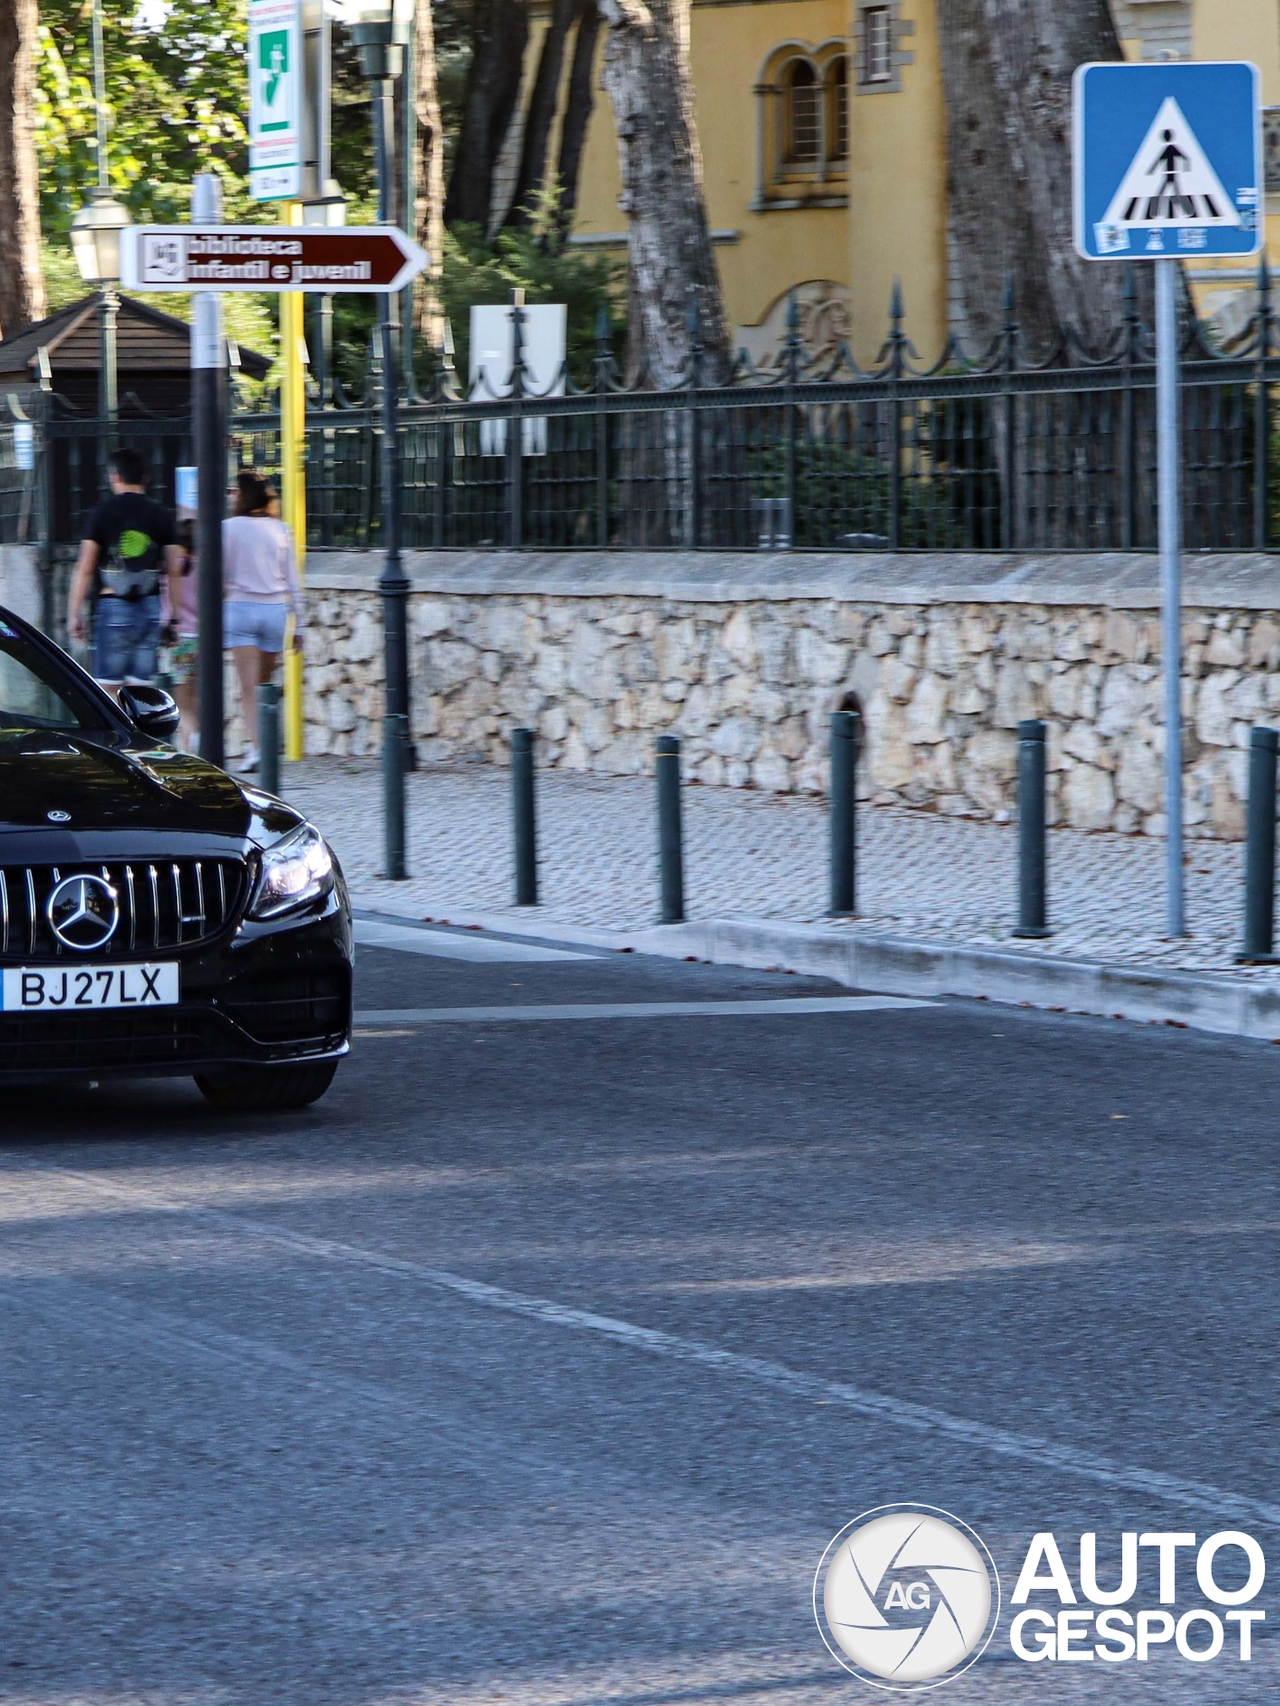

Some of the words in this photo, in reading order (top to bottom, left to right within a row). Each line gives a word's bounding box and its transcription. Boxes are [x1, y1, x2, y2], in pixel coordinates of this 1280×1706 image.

[188, 235, 303, 256] biblioteca
[188, 260, 269, 279] infantil
[272, 263, 290, 279] e
[290, 260, 372, 284] juvenil
[21, 968, 162, 1007] BJ27LX
